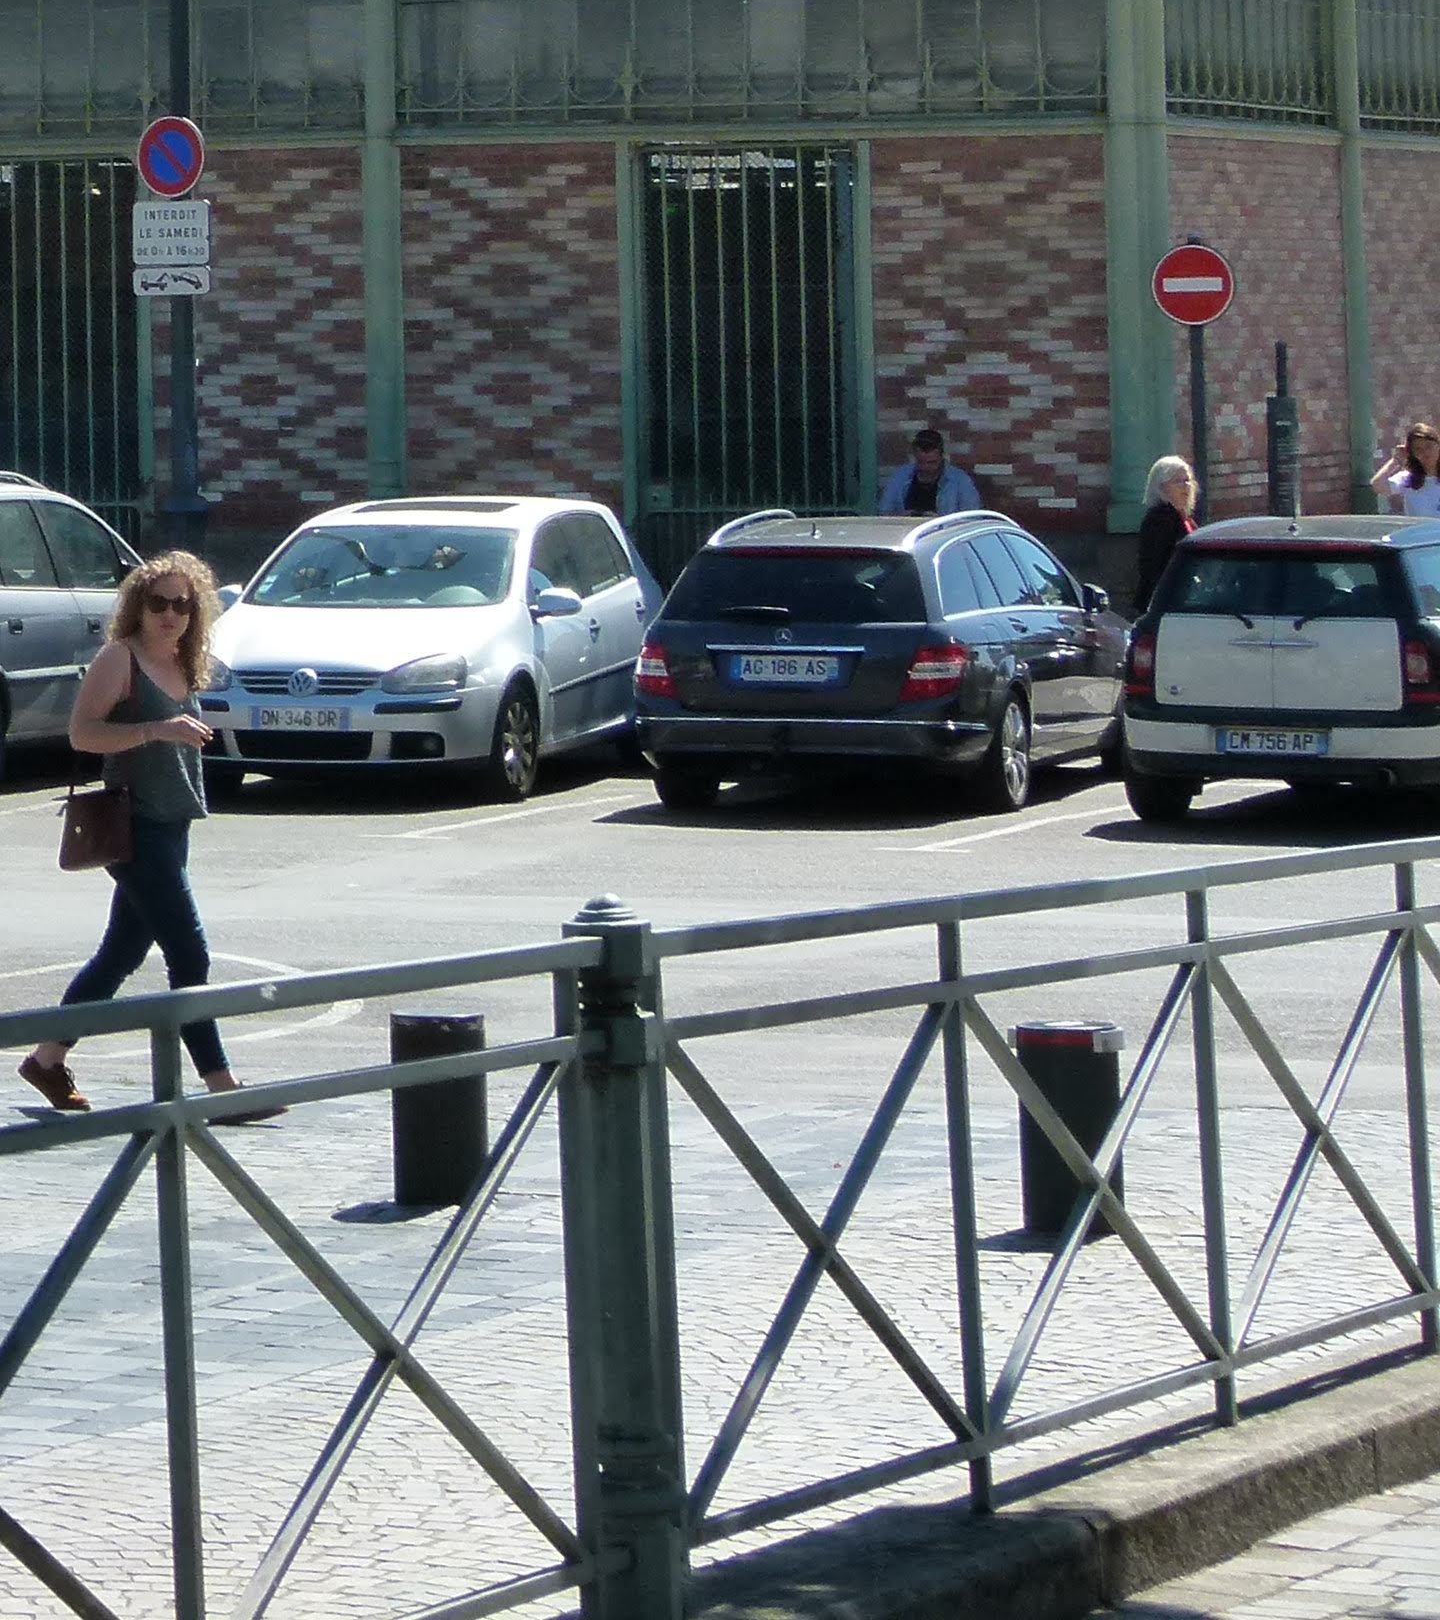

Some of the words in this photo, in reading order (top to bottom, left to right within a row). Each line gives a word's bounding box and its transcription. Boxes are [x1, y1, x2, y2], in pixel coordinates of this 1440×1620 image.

[144, 210, 196, 220] INTERDIT
[140, 228, 152, 238] LE
[159, 228, 203, 238] SAMEDI
